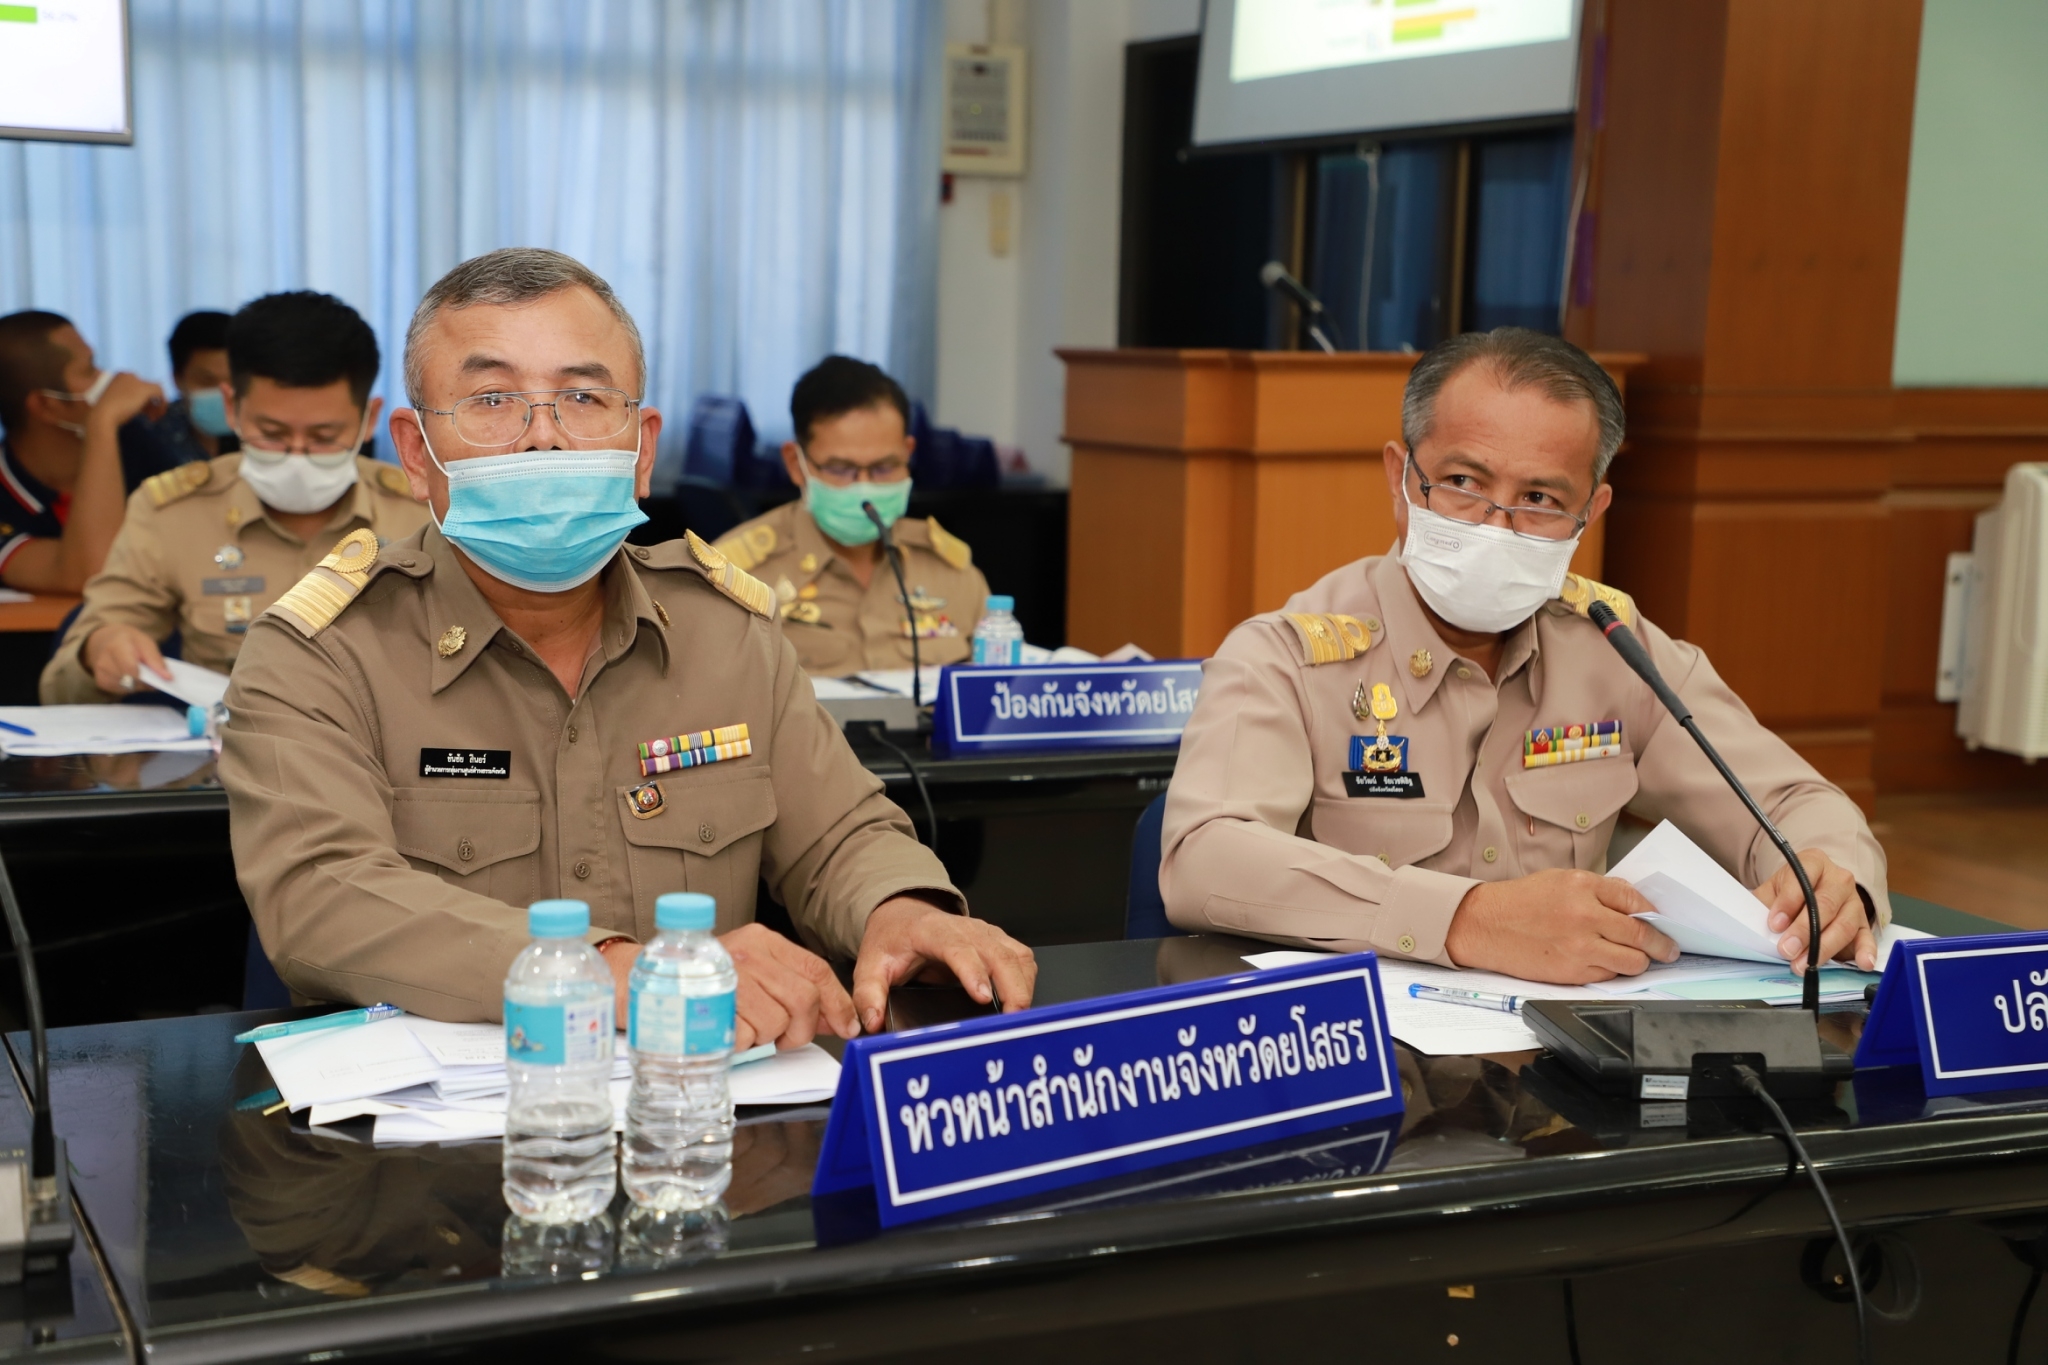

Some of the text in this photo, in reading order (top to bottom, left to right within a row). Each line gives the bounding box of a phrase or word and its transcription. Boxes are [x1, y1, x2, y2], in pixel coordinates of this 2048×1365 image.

[899, 1005, 1368, 1154] หัวหน้าสำนักงานจังหวัดยโสธร
